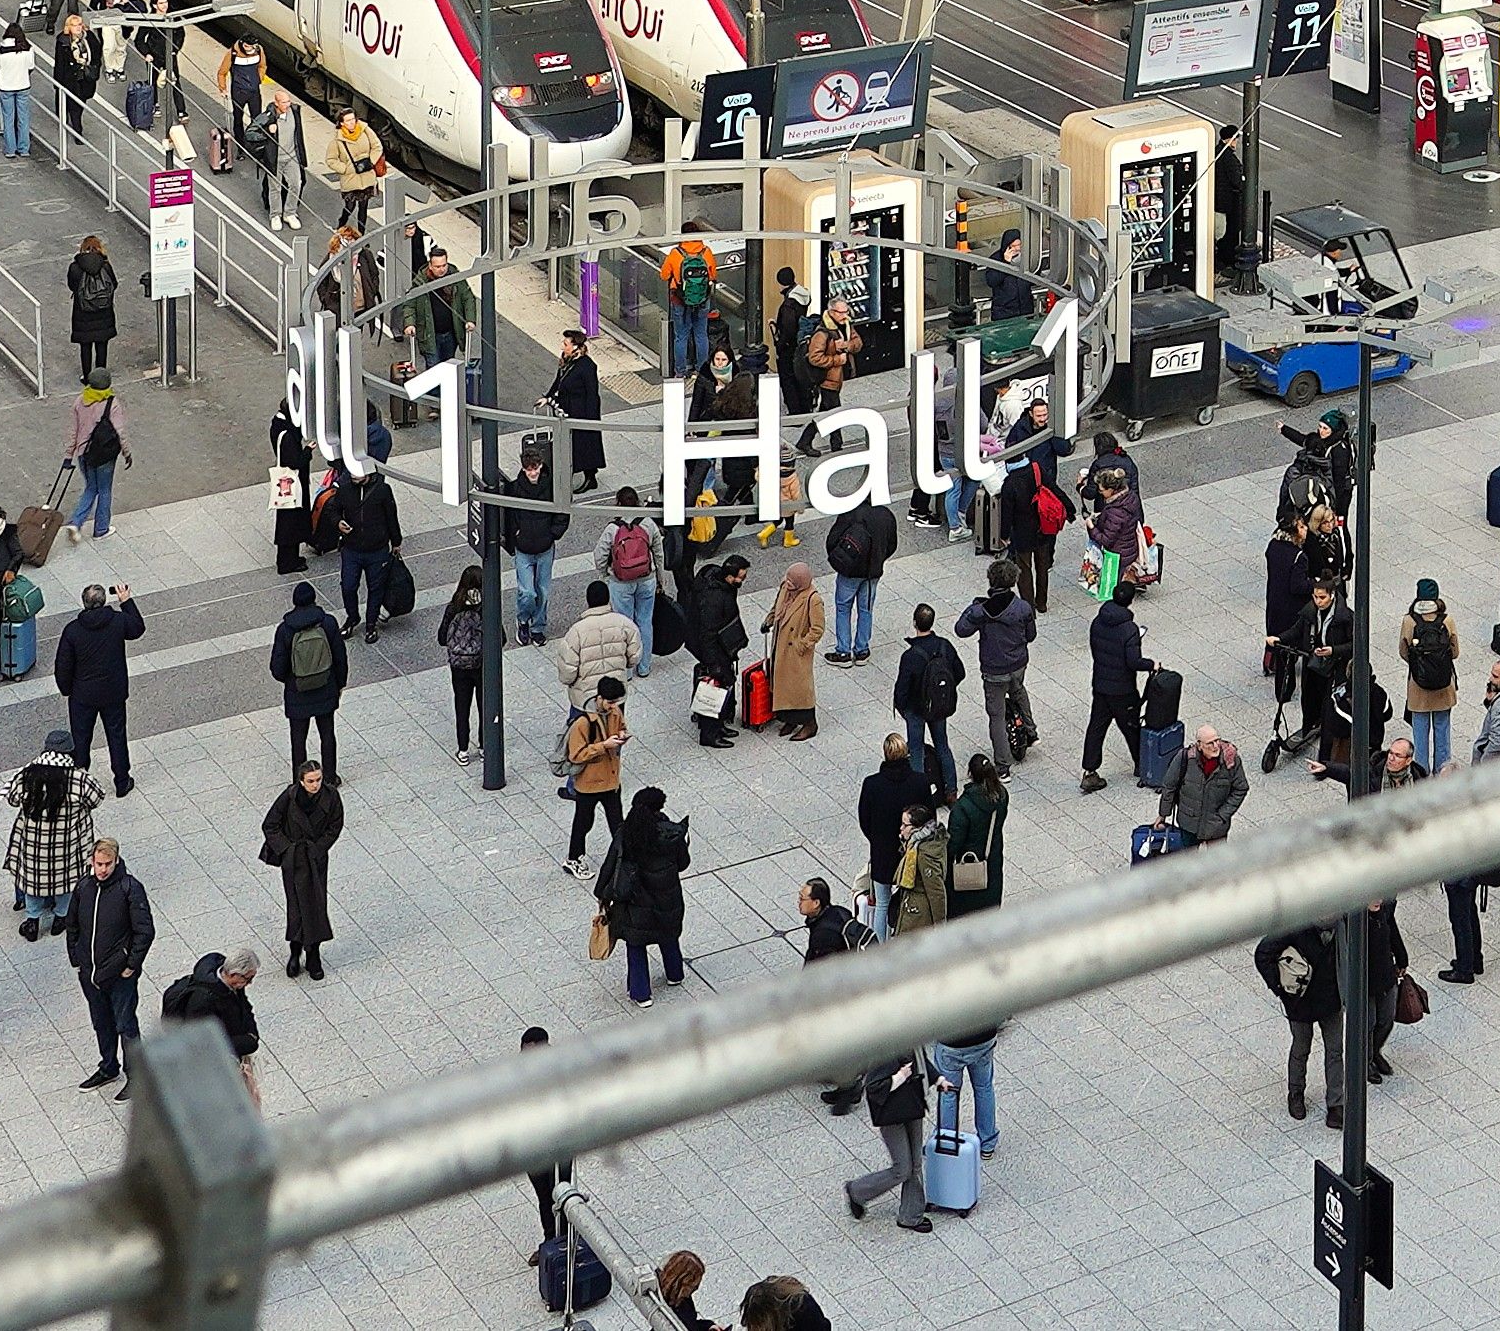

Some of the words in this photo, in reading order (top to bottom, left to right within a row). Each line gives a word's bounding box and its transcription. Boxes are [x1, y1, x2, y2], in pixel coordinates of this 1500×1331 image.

[1152, 12, 1190, 25] Attentifs
[1288, 15, 1320, 45] 11
[800, 34, 827, 46] SNCF
[540, 54, 568, 67] SNCF
[727, 95, 747, 105] Voie
[428, 104, 443, 119] 207
[716, 107, 756, 140] 10
[788, 130, 801, 140] Ne
[803, 125, 829, 139] prend
[832, 123, 847, 134] pas
[850, 120, 861, 130] de
[862, 114, 906, 130] voyageurs
[857, 192, 885, 204] selecta
[1155, 350, 1199, 370] ONET
[287, 310, 377, 478] all
[404, 358, 466, 506] 1
[663, 336, 996, 526] Hall
[1031, 297, 1081, 440] 1
